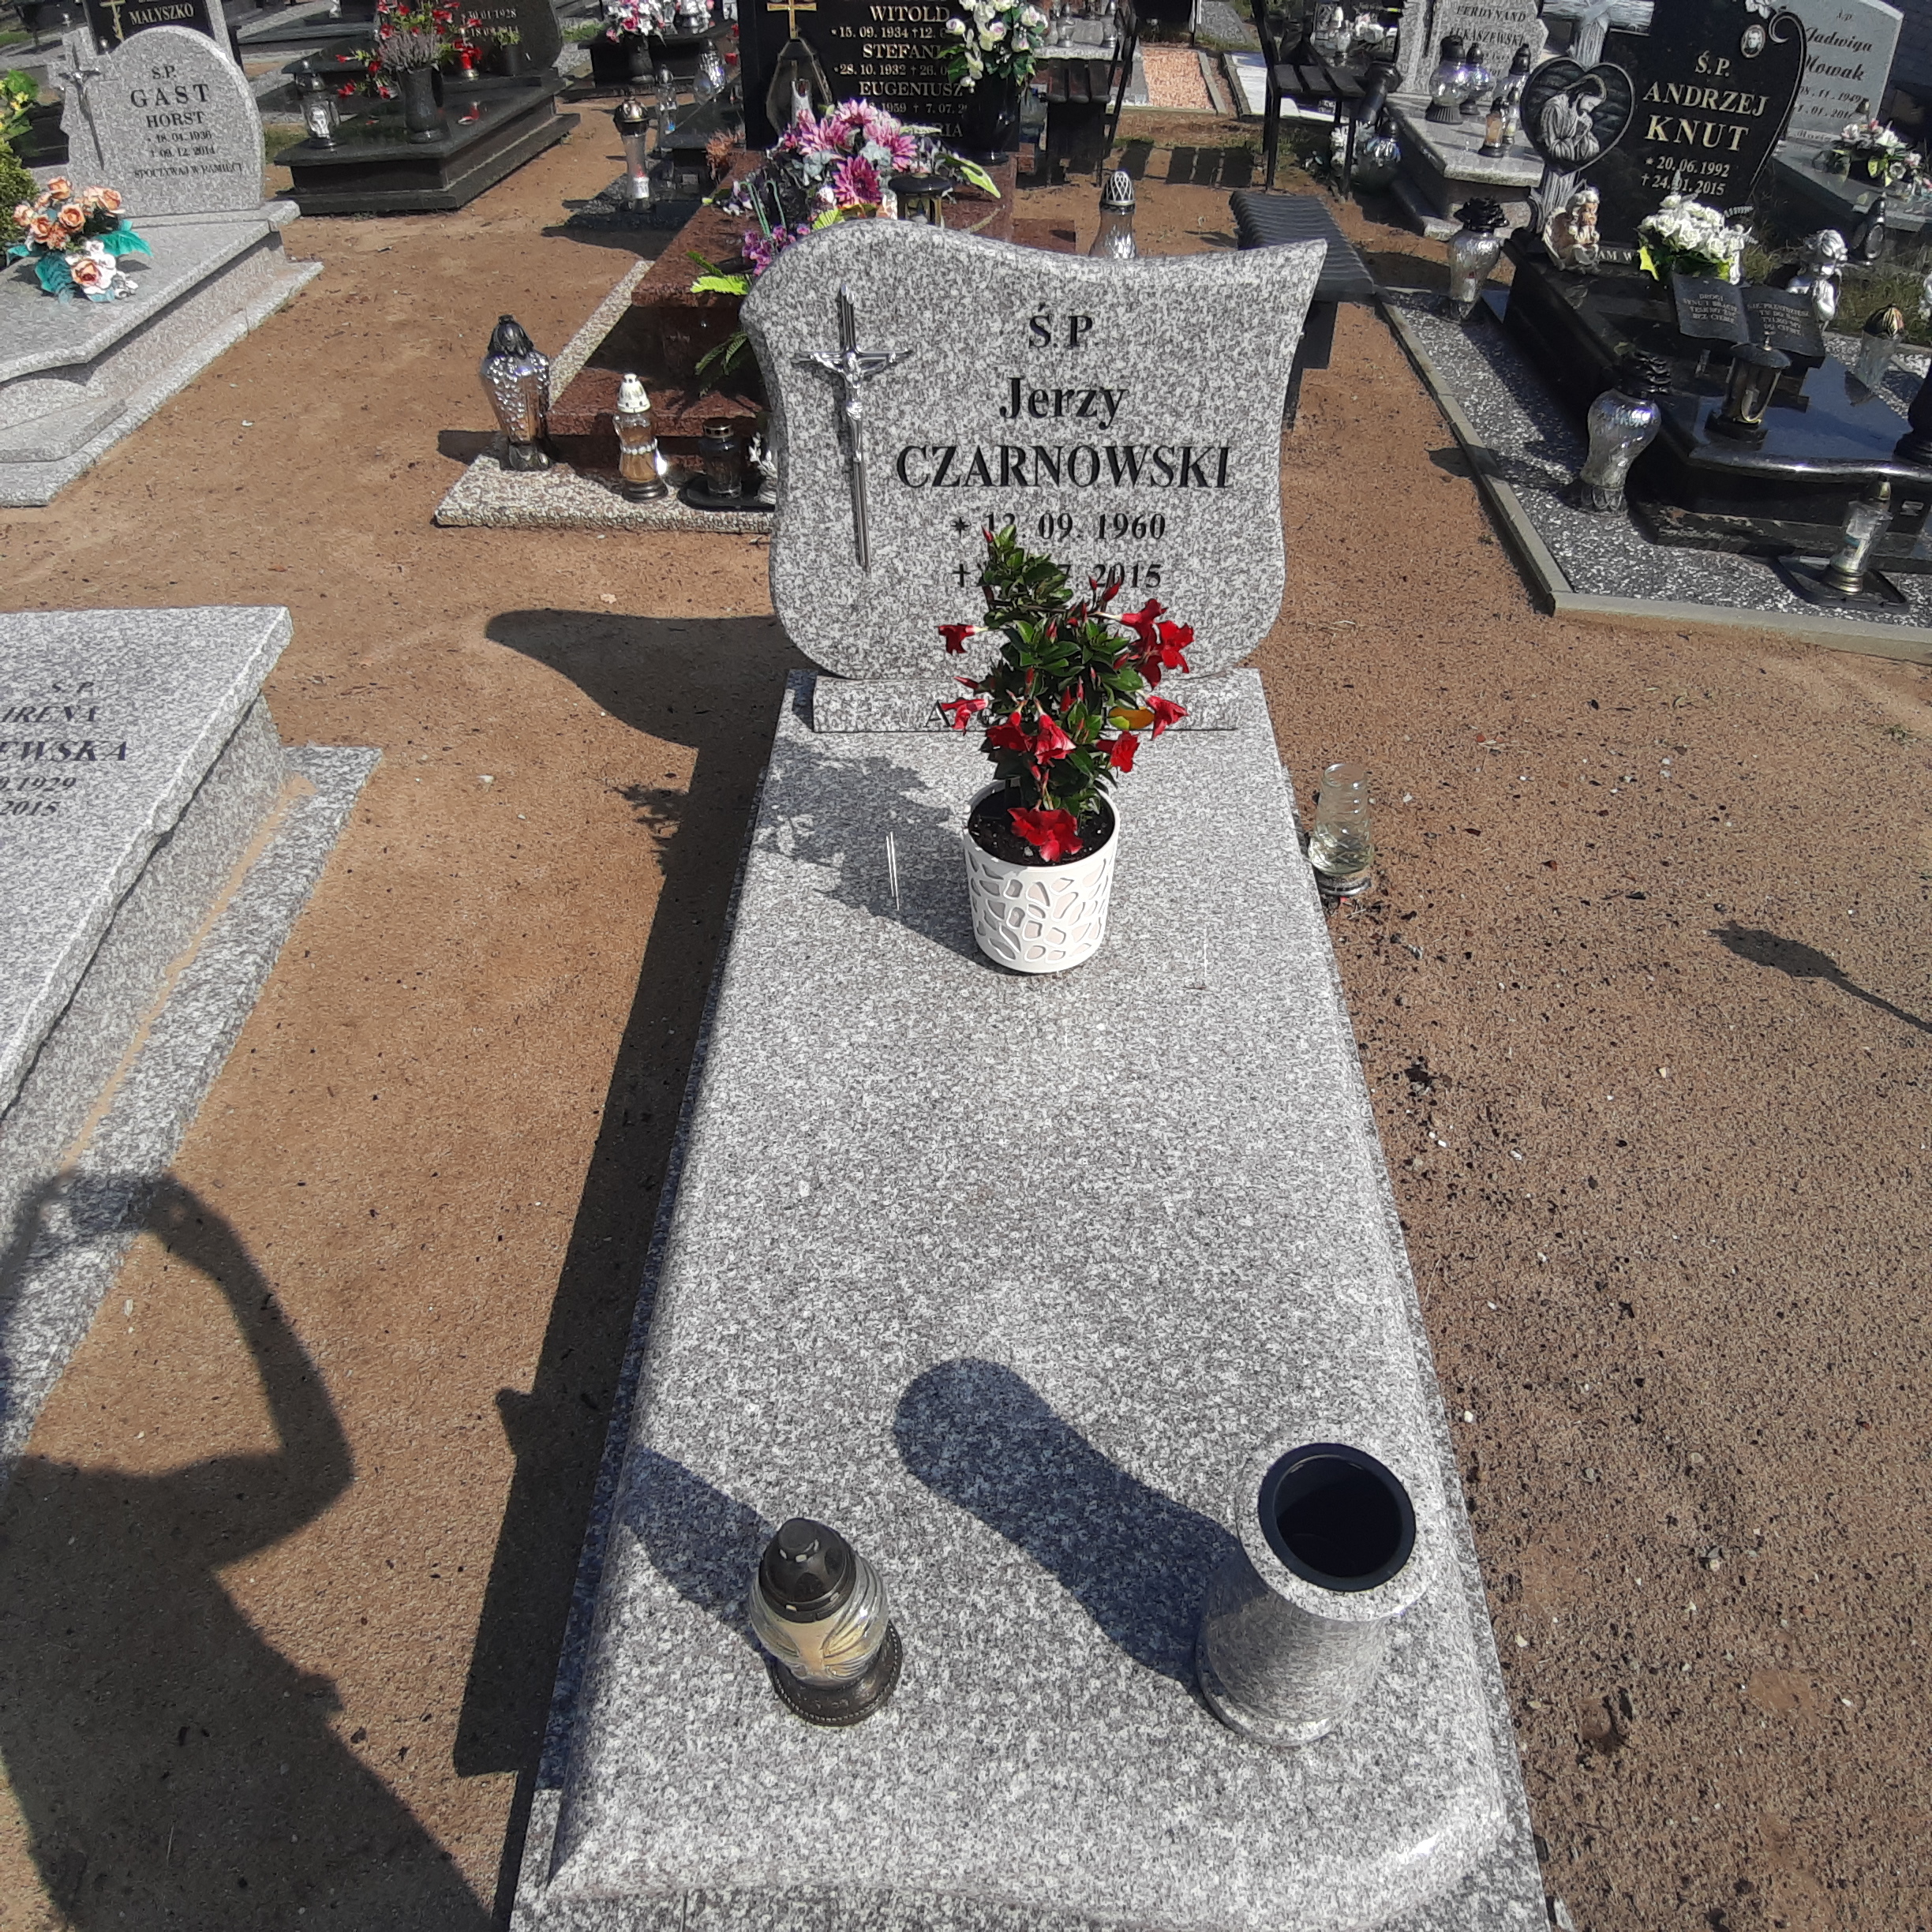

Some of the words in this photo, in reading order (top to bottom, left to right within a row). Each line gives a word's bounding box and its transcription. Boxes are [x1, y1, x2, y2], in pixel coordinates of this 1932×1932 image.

[870, 6, 949, 22] WITOLD
[130, 84, 210, 108] GAST
[859, 81, 964, 97] EUGENIUSZ
[1642, 81, 1770, 117] ANDRZEJ
[146, 111, 206, 128] HORST
[1644, 114, 1750, 152] KNUT
[999, 376, 1130, 430] Jerzy
[896, 444, 1232, 489] CZARNOWSKI
[1098, 513, 1166, 540] 1960
